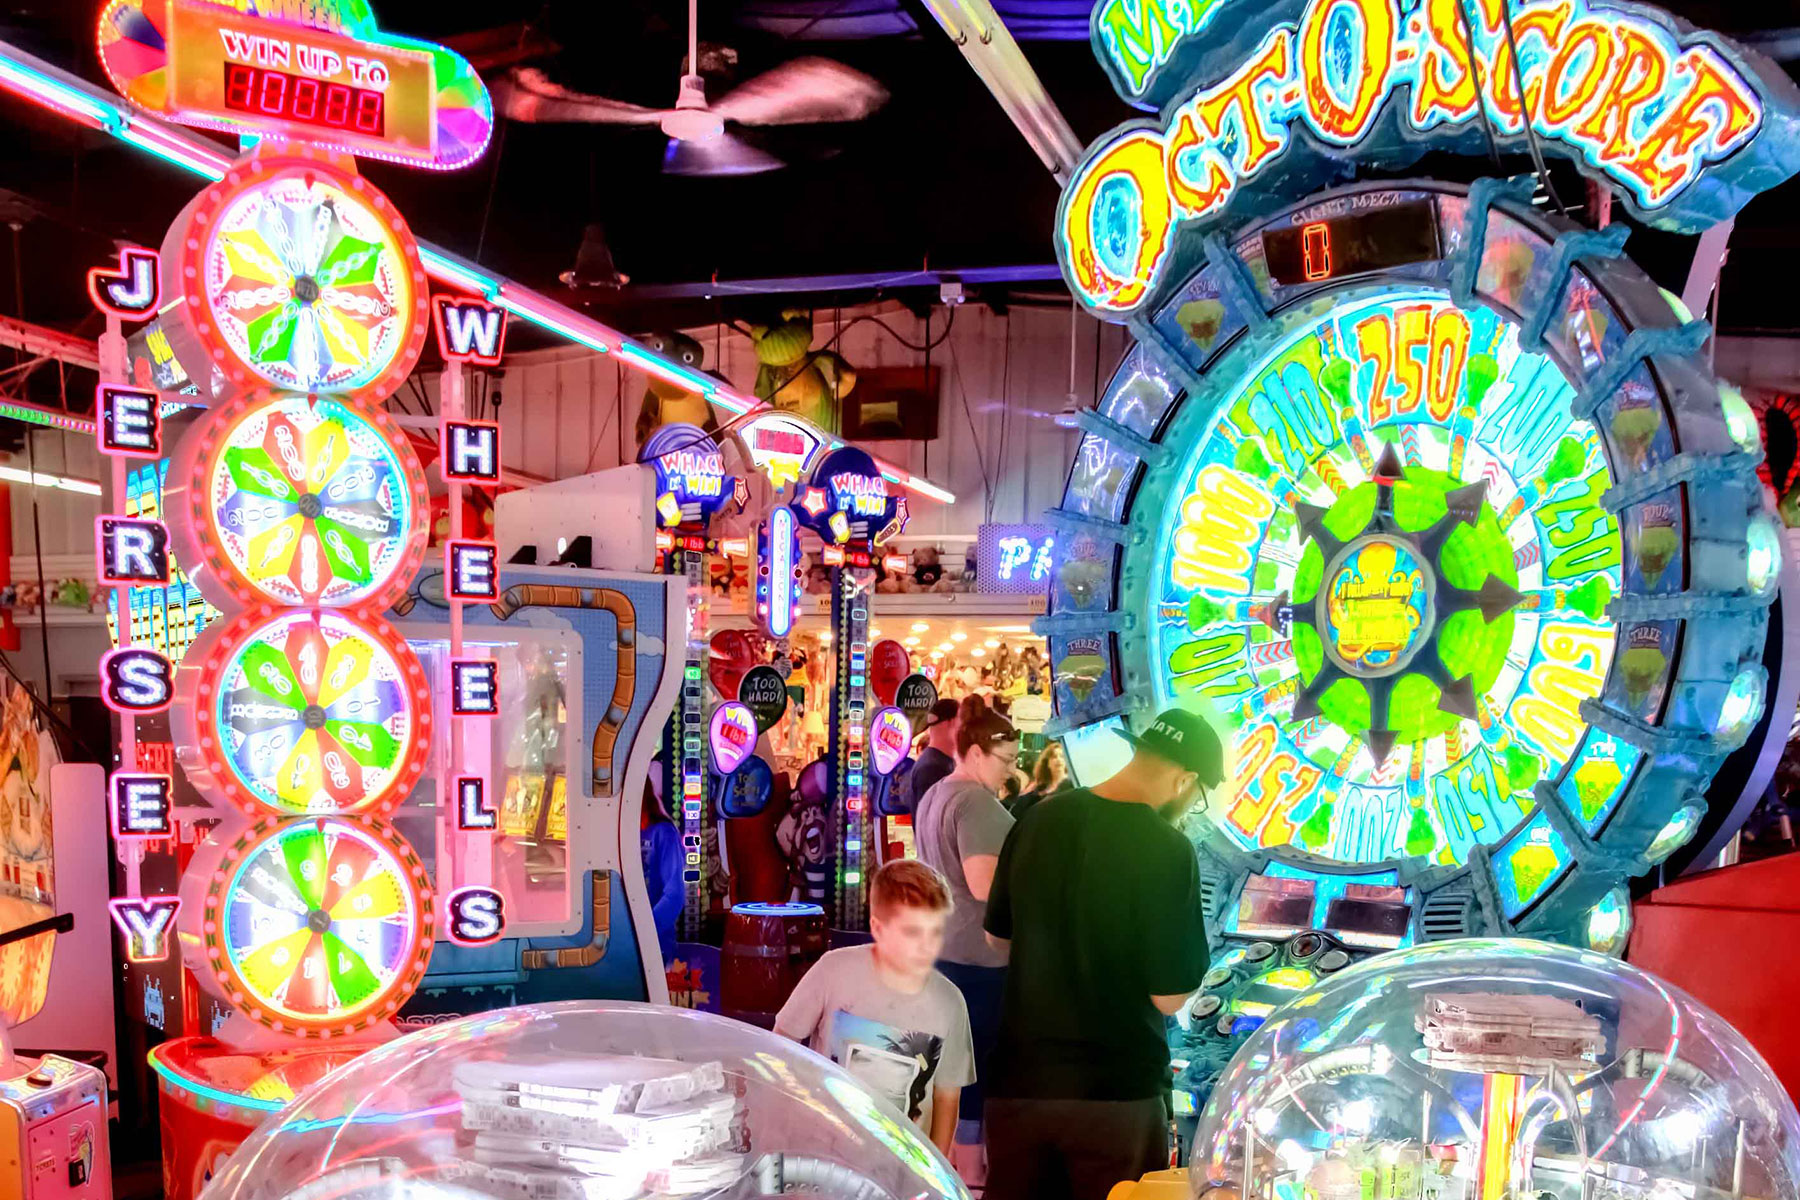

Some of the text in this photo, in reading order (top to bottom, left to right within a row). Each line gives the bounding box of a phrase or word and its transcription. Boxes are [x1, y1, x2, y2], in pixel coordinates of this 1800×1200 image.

[219, 28, 390, 90] WIN UP TO
[1303, 222, 1330, 281] 0
[1355, 304, 1470, 426] 250
[1250, 360, 1335, 471] 210
[1475, 353, 1578, 475] 200
[1172, 462, 1276, 595] 1000
[101, 254, 176, 960] JERSEY
[443, 303, 504, 943] WHEELS
[1628, 626, 1662, 644] THREE
[1067, 638, 1101, 651] THREE
[748, 689, 783, 704] HARD!
[752, 677, 777, 689] TOO
[908, 684, 930, 696] TOO
[1152, 720, 1184, 742] ATA
